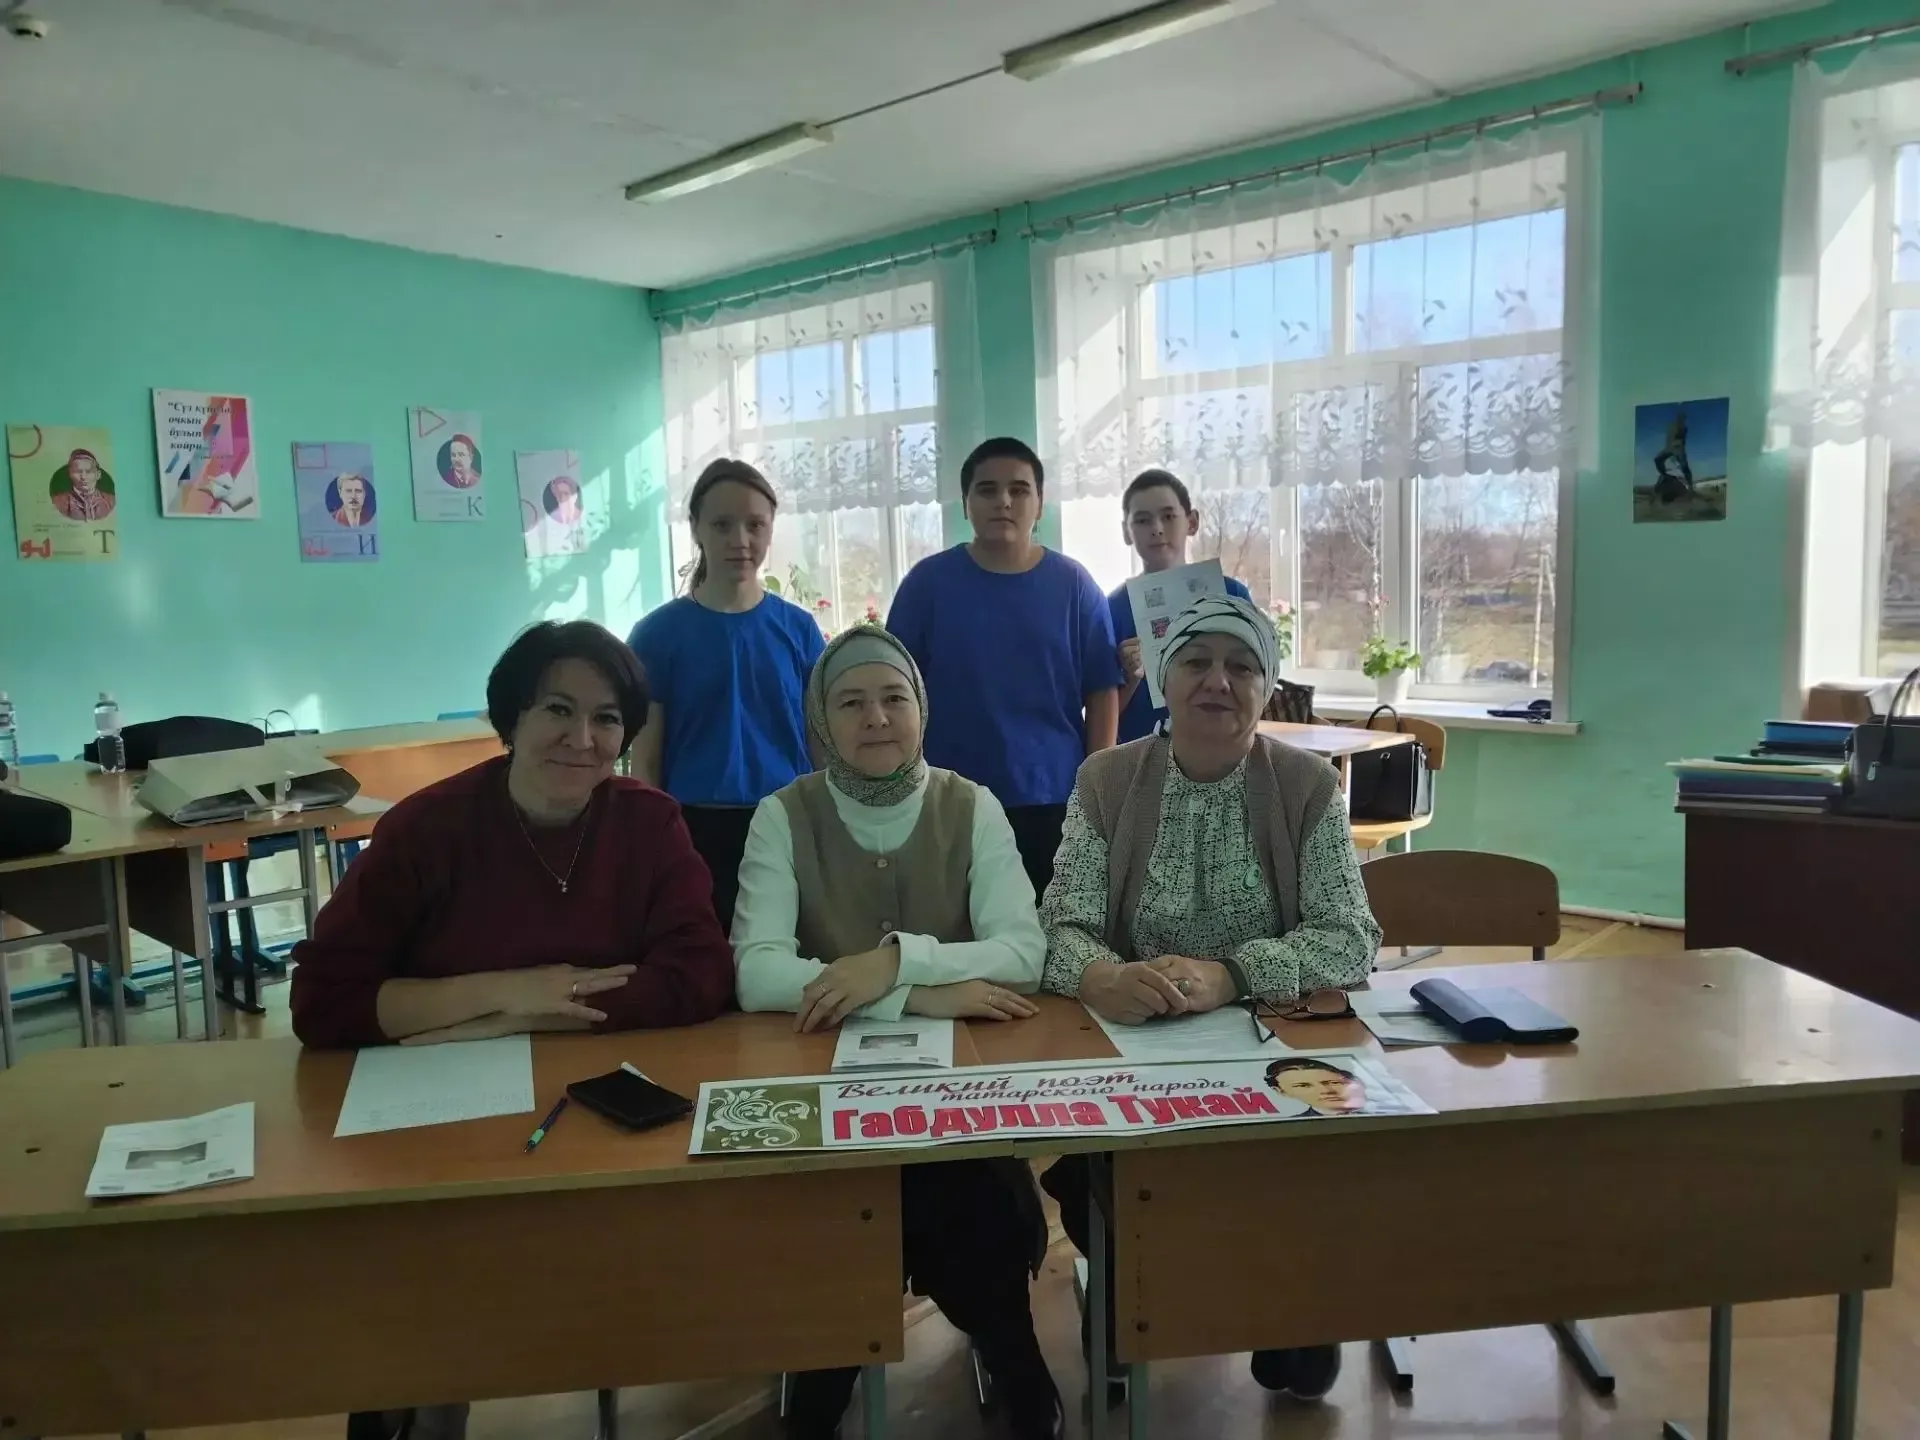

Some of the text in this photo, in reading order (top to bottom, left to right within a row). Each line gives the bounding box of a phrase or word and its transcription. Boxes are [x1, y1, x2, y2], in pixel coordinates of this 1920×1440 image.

[467, 496, 483, 517] К
[357, 533, 379, 555] И
[837, 1071, 1140, 1100] Великий поэт
[941, 1078, 1231, 1103] татарского народа
[832, 1086, 1281, 1141] Габдулла Тукай
